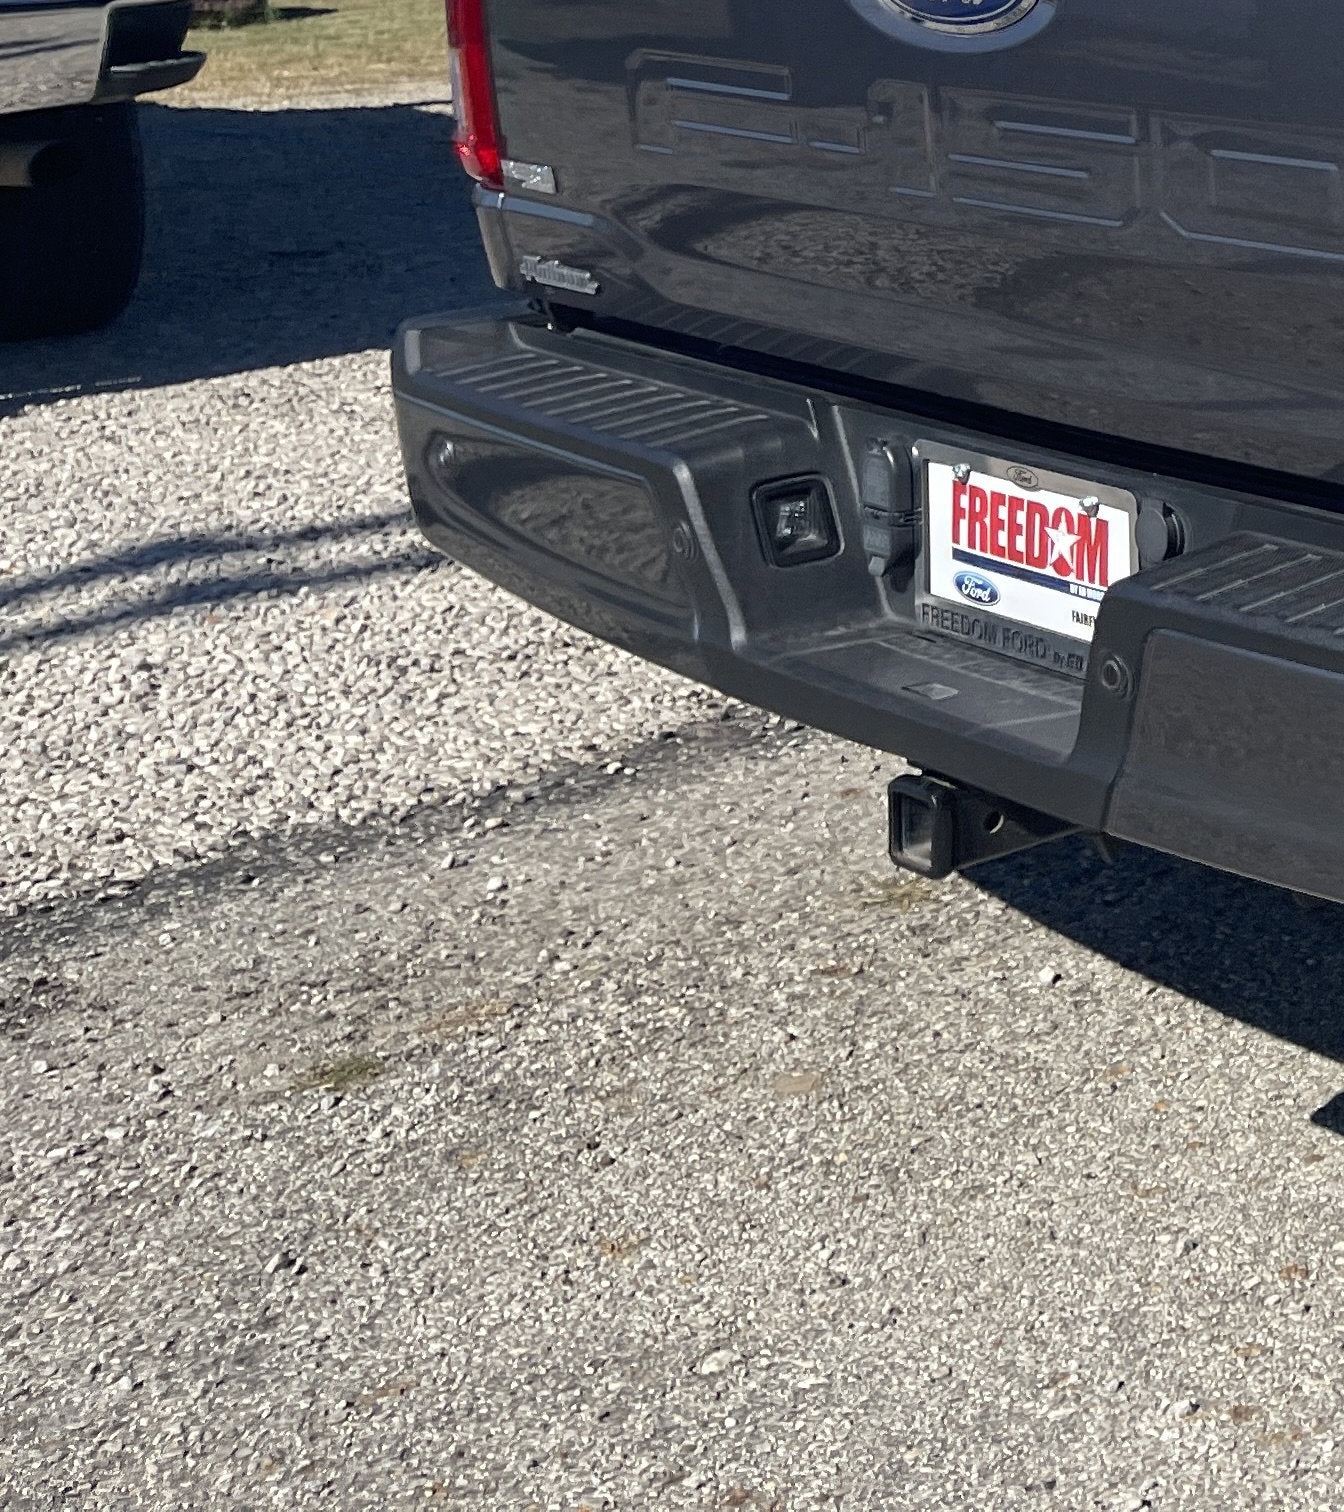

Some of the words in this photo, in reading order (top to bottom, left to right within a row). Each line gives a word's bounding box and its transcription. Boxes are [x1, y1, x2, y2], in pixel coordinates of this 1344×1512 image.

[952, 480, 1109, 588] FREEDOM
[961, 576, 991, 603] Ford
[921, 602, 998, 645] FREEDOM
[1000, 626, 1047, 660] FORD
